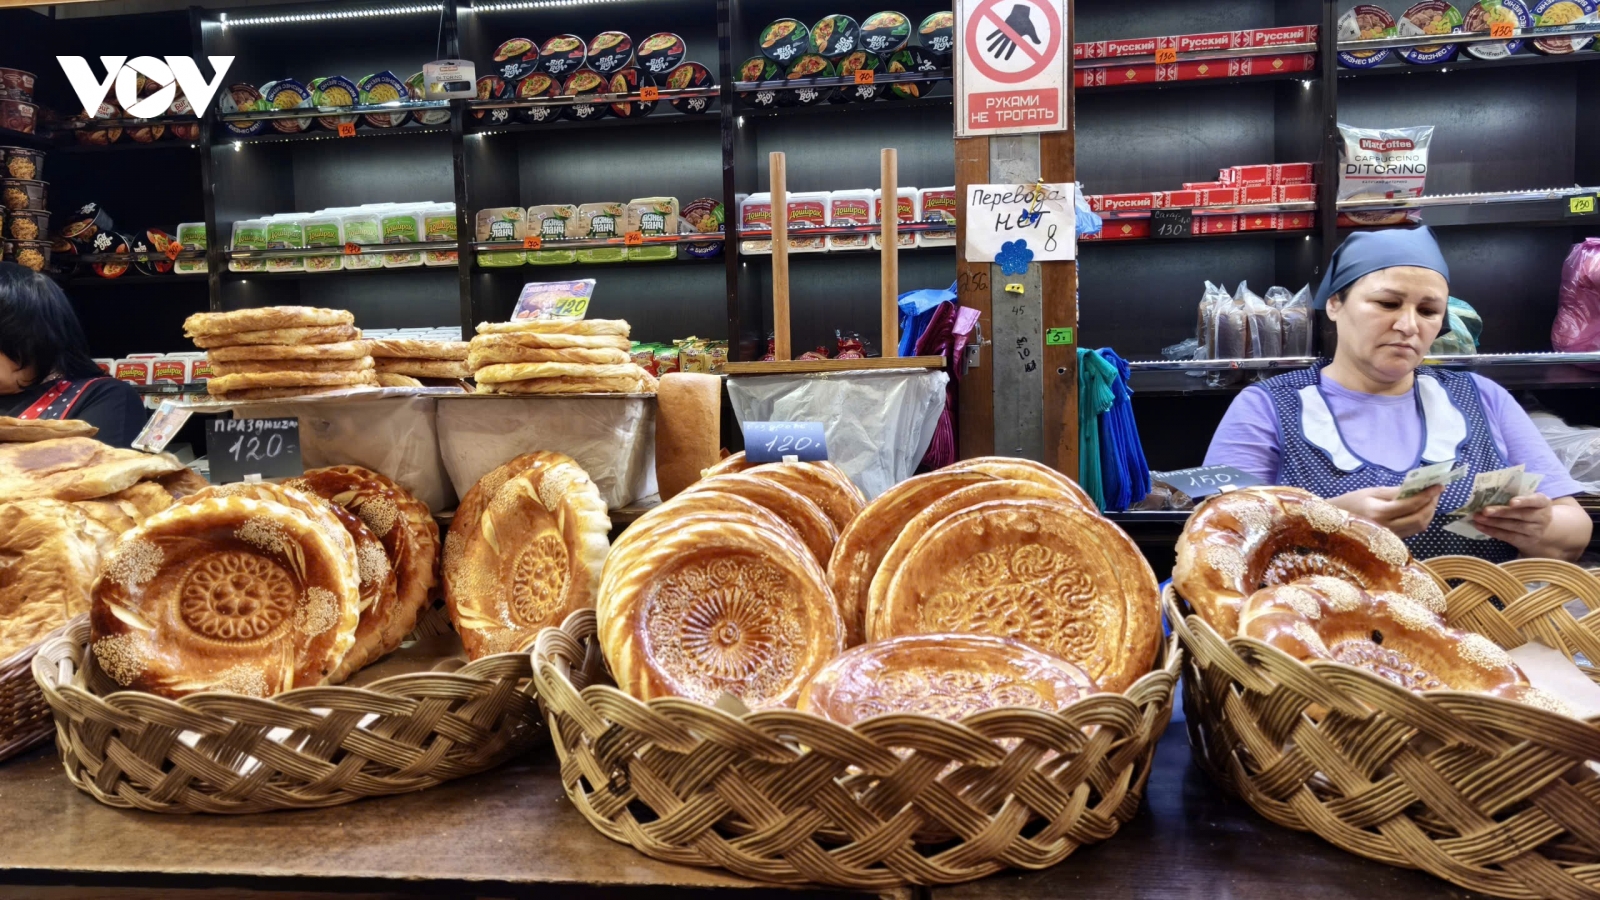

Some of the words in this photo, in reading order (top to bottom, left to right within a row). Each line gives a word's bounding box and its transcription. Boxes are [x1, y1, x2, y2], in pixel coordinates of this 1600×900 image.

[1181, 35, 1229, 48] Русский
[1256, 29, 1304, 43] Русский
[1109, 41, 1155, 54] Русский
[986, 95, 1040, 109] РУКАМИ
[971, 111, 989, 123] НЕ
[995, 108, 1054, 122] ТРОГАТЬ
[1354, 155, 1420, 163] CAPPUCCINO
[1105, 198, 1151, 209] Русский
[789, 209, 822, 220] Доширак
[833, 206, 866, 217] Доширак
[1045, 224, 1057, 252] 8
[1012, 305, 1025, 316] 45
[154, 368, 182, 378] Доширак
